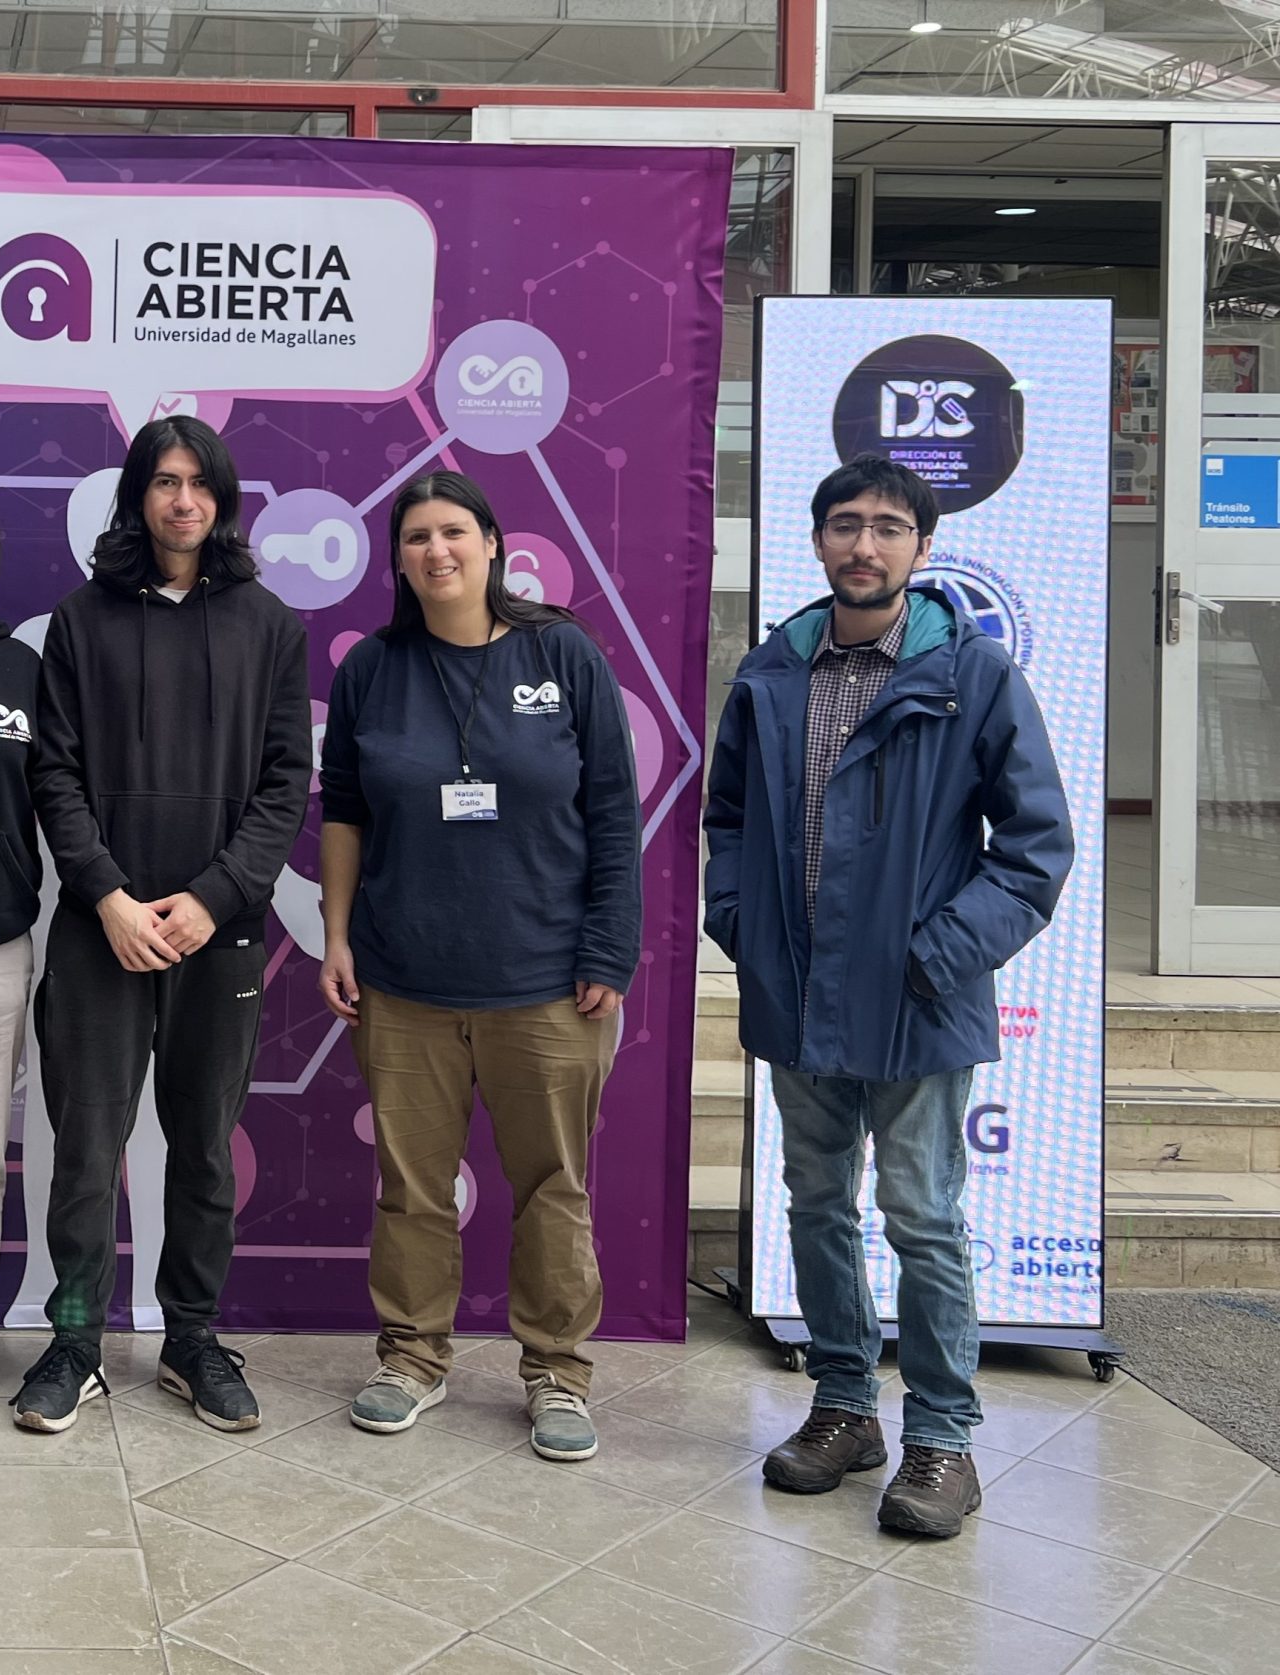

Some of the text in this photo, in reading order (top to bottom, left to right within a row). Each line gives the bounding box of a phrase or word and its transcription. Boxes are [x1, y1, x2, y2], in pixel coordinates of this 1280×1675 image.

[143, 241, 351, 281] CIENCIA
[136, 283, 354, 323] ABIERTA
[134, 326, 357, 348] Universidad de Magallanes
[457, 399, 543, 409] CIENCIA ABIERTA
[1205, 502, 1251, 513] Tránsito
[1204, 513, 1256, 524] Peatones
[454, 790, 484, 798] Natalia
[1011, 1235, 1101, 1252] acceso
